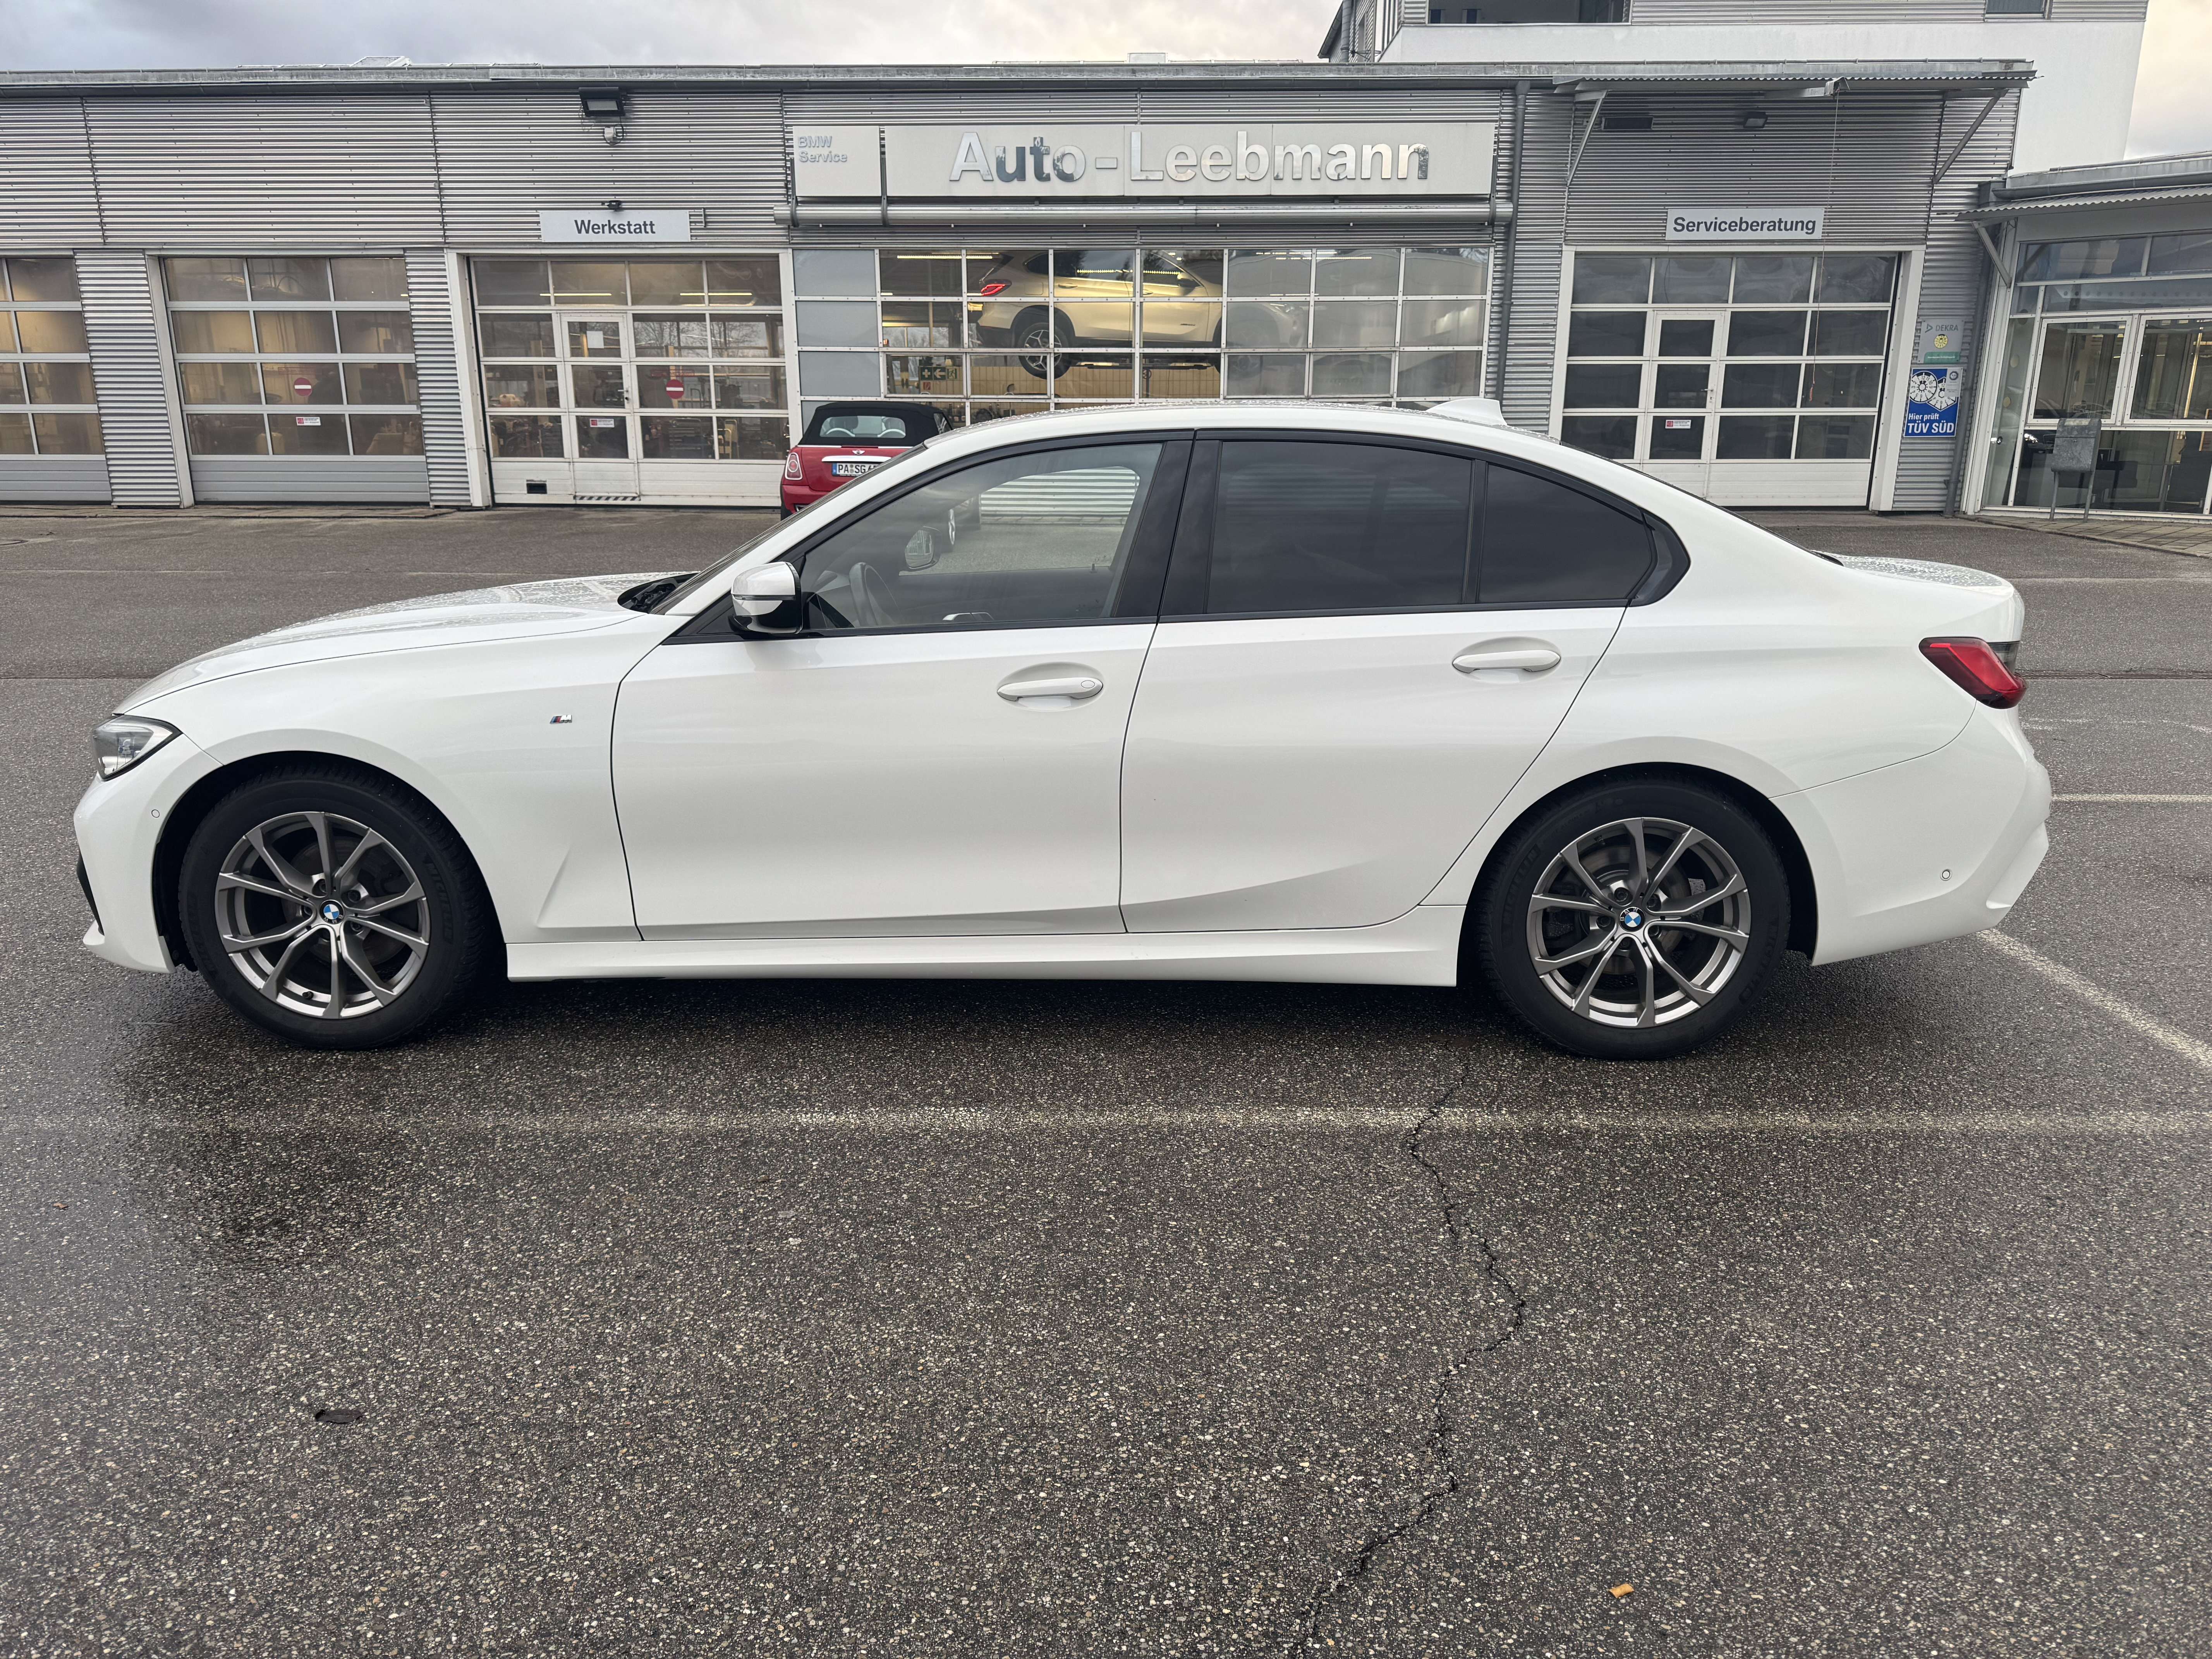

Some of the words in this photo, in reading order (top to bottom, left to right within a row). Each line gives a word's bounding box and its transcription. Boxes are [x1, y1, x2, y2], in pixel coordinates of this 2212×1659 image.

[798, 136, 832, 148] BMW
[799, 150, 848, 163] Service
[949, 131, 1429, 182] Auto-Leebmann
[574, 220, 656, 234] Werkstatt
[1673, 217, 1816, 235] Serviceberatung
[1923, 413, 1939, 421] prüft
[1908, 421, 1929, 433] TÜV
[1931, 420, 1954, 433] SÜD
[838, 464, 849, 473] PA
